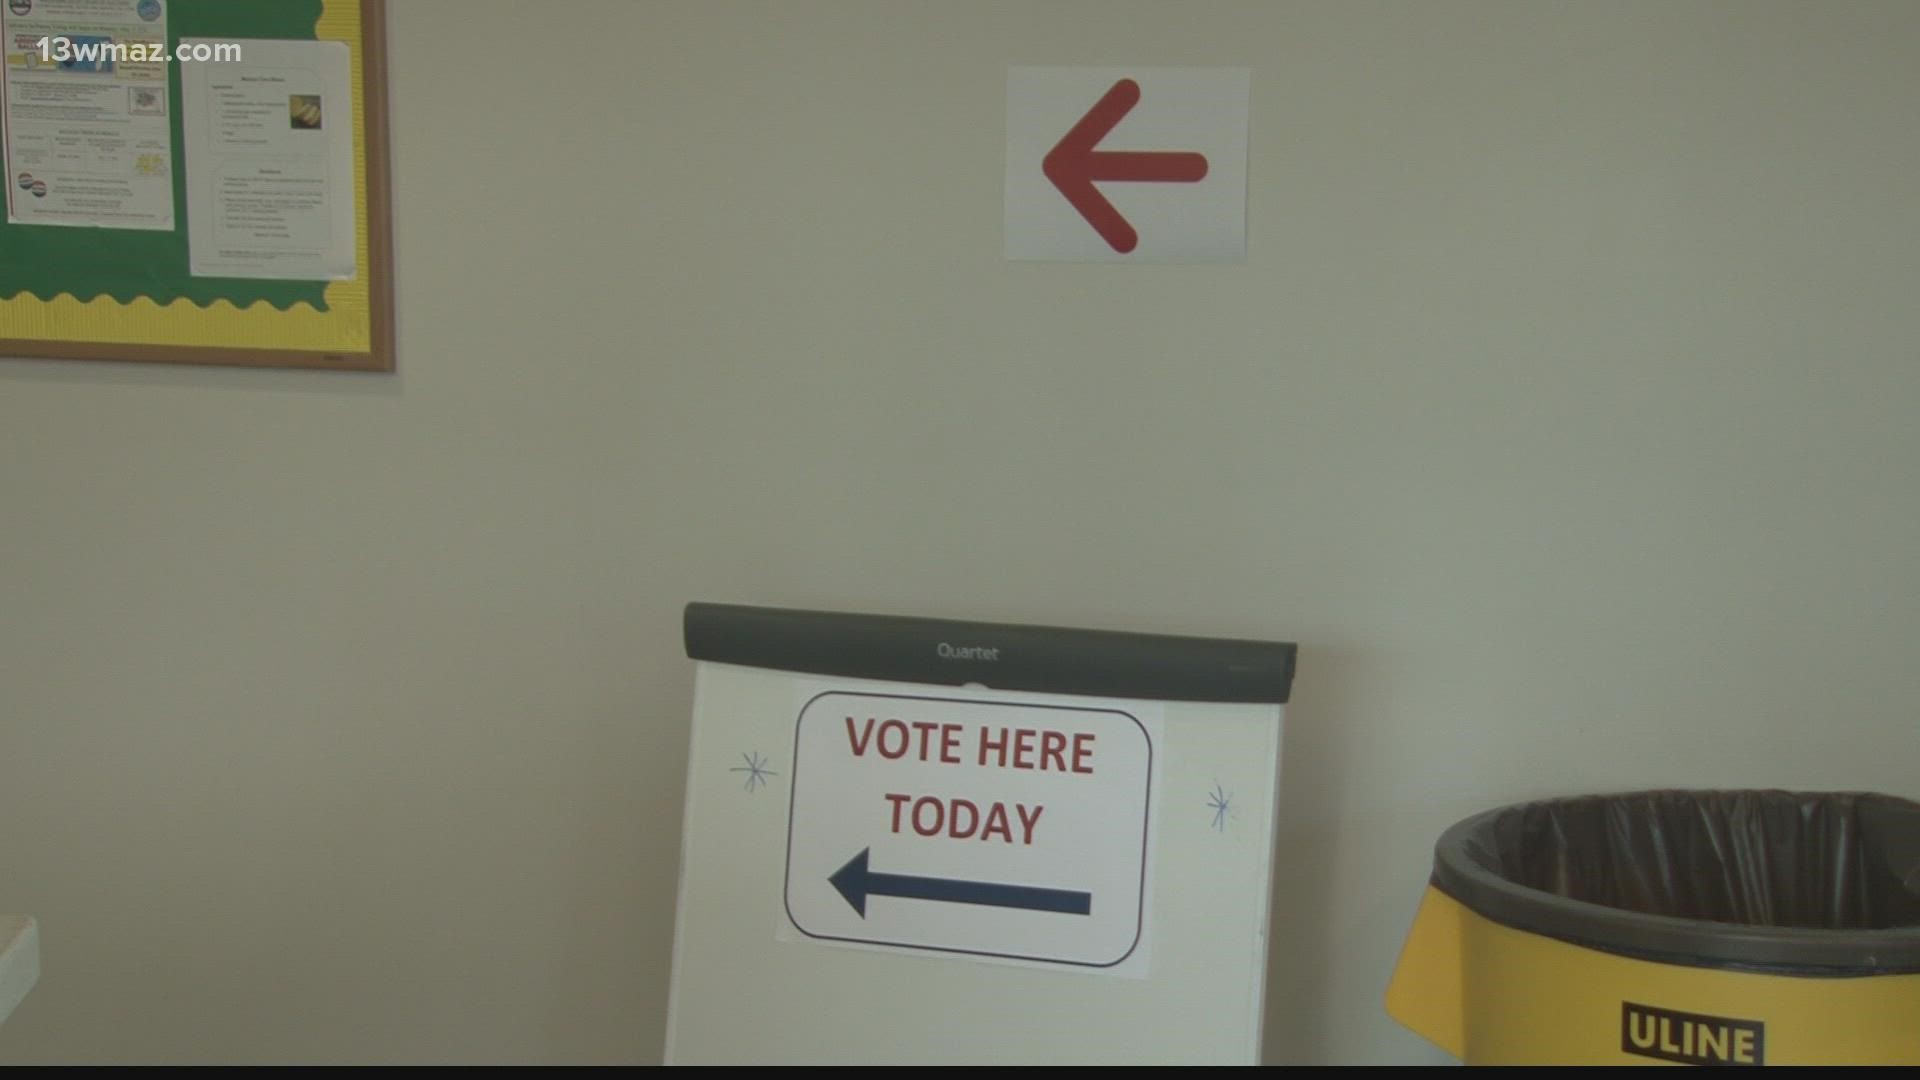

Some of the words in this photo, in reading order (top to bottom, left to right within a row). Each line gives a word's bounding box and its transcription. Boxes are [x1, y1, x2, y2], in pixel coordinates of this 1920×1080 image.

[937, 642, 999, 661] Quartet
[845, 716, 963, 764] VOTE
[978, 726, 1095, 774] HERE
[885, 793, 1044, 845] TODAY
[1629, 1011, 1754, 1063] ULINE
